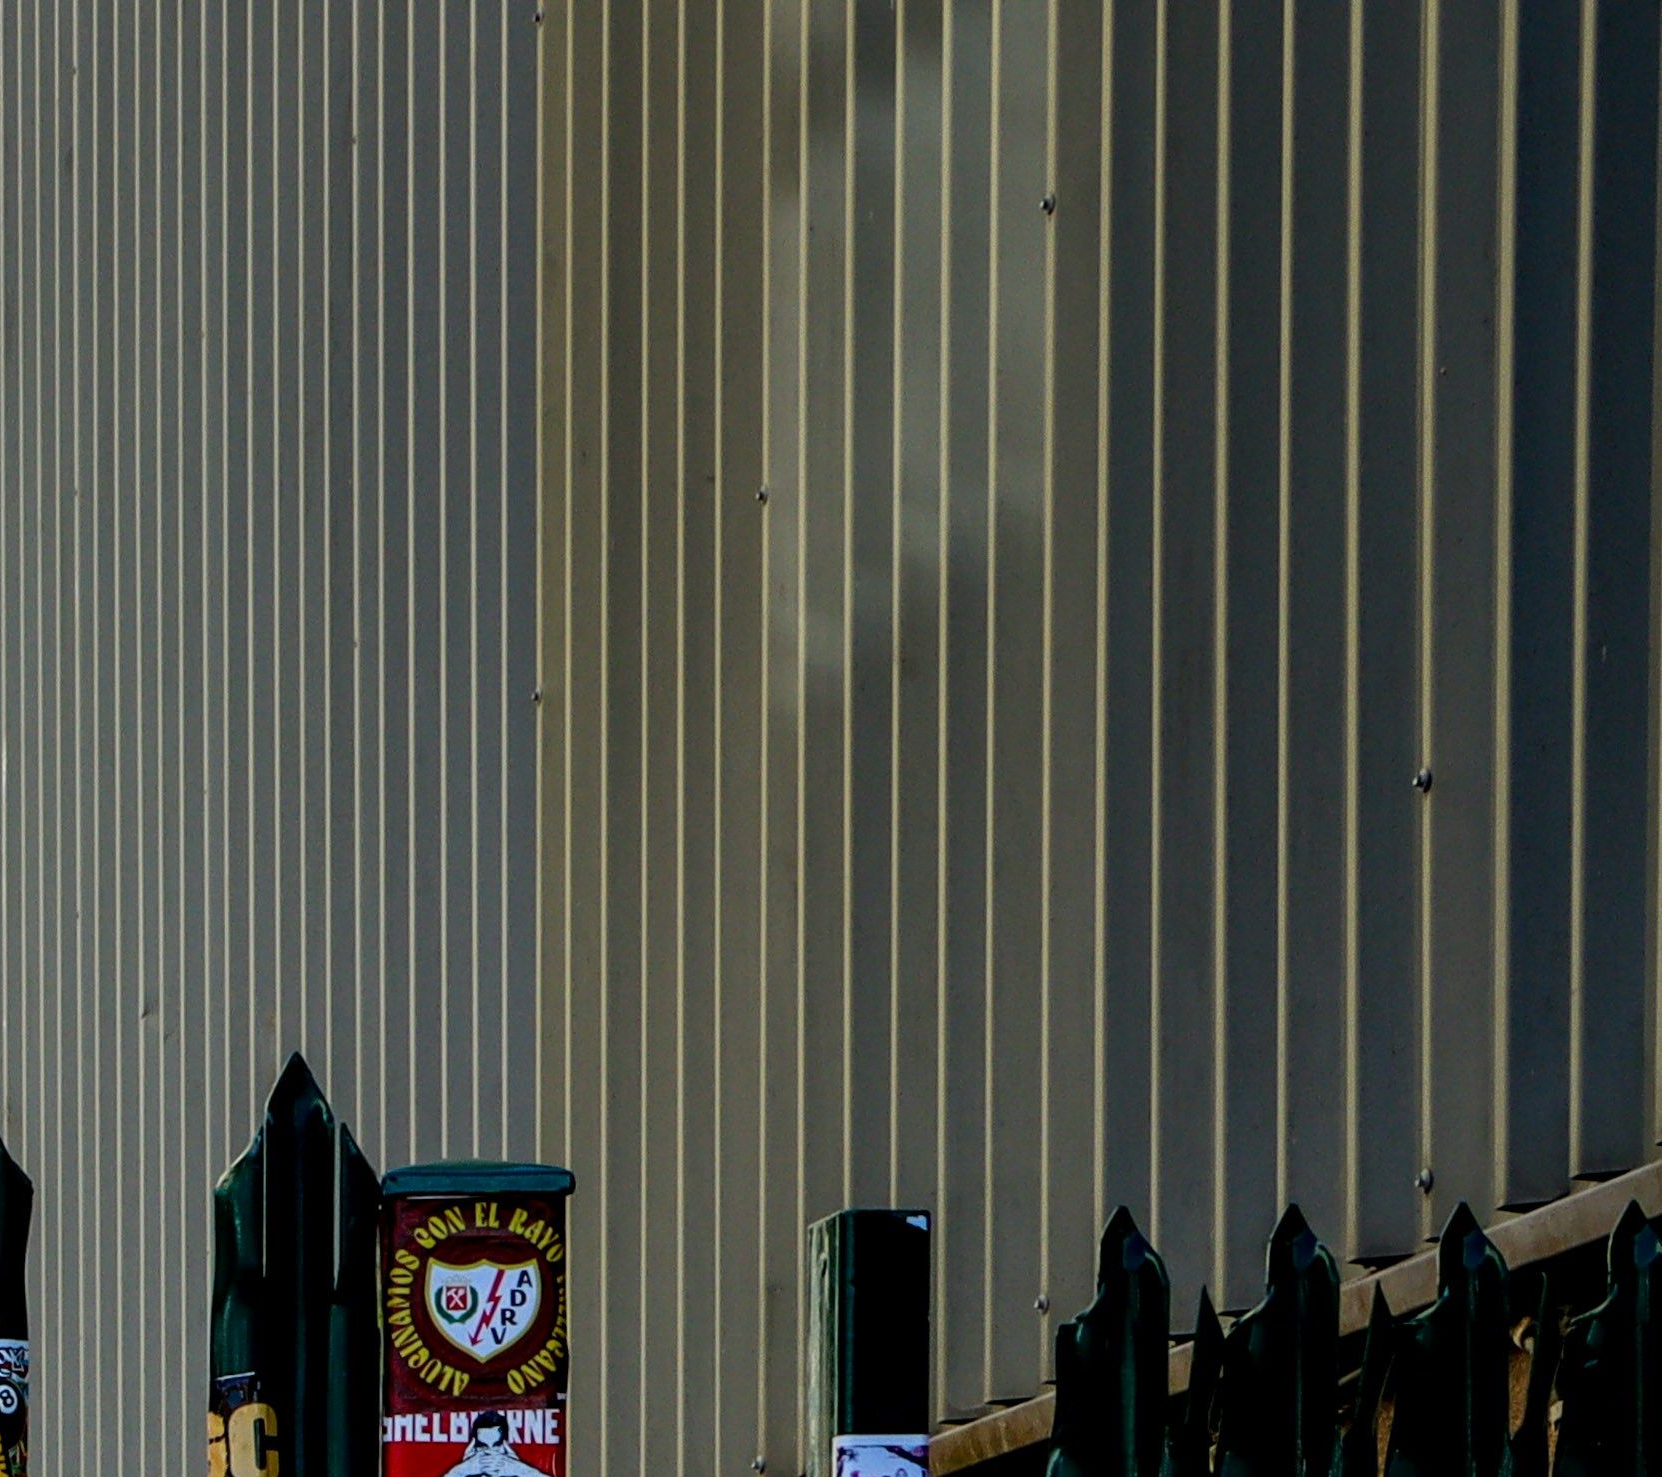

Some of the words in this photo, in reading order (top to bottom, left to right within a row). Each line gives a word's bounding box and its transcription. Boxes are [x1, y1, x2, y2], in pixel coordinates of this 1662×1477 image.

[415, 1207, 466, 1249] CON
[476, 1202, 500, 1230] EL
[509, 1208, 565, 1266] RAYO
